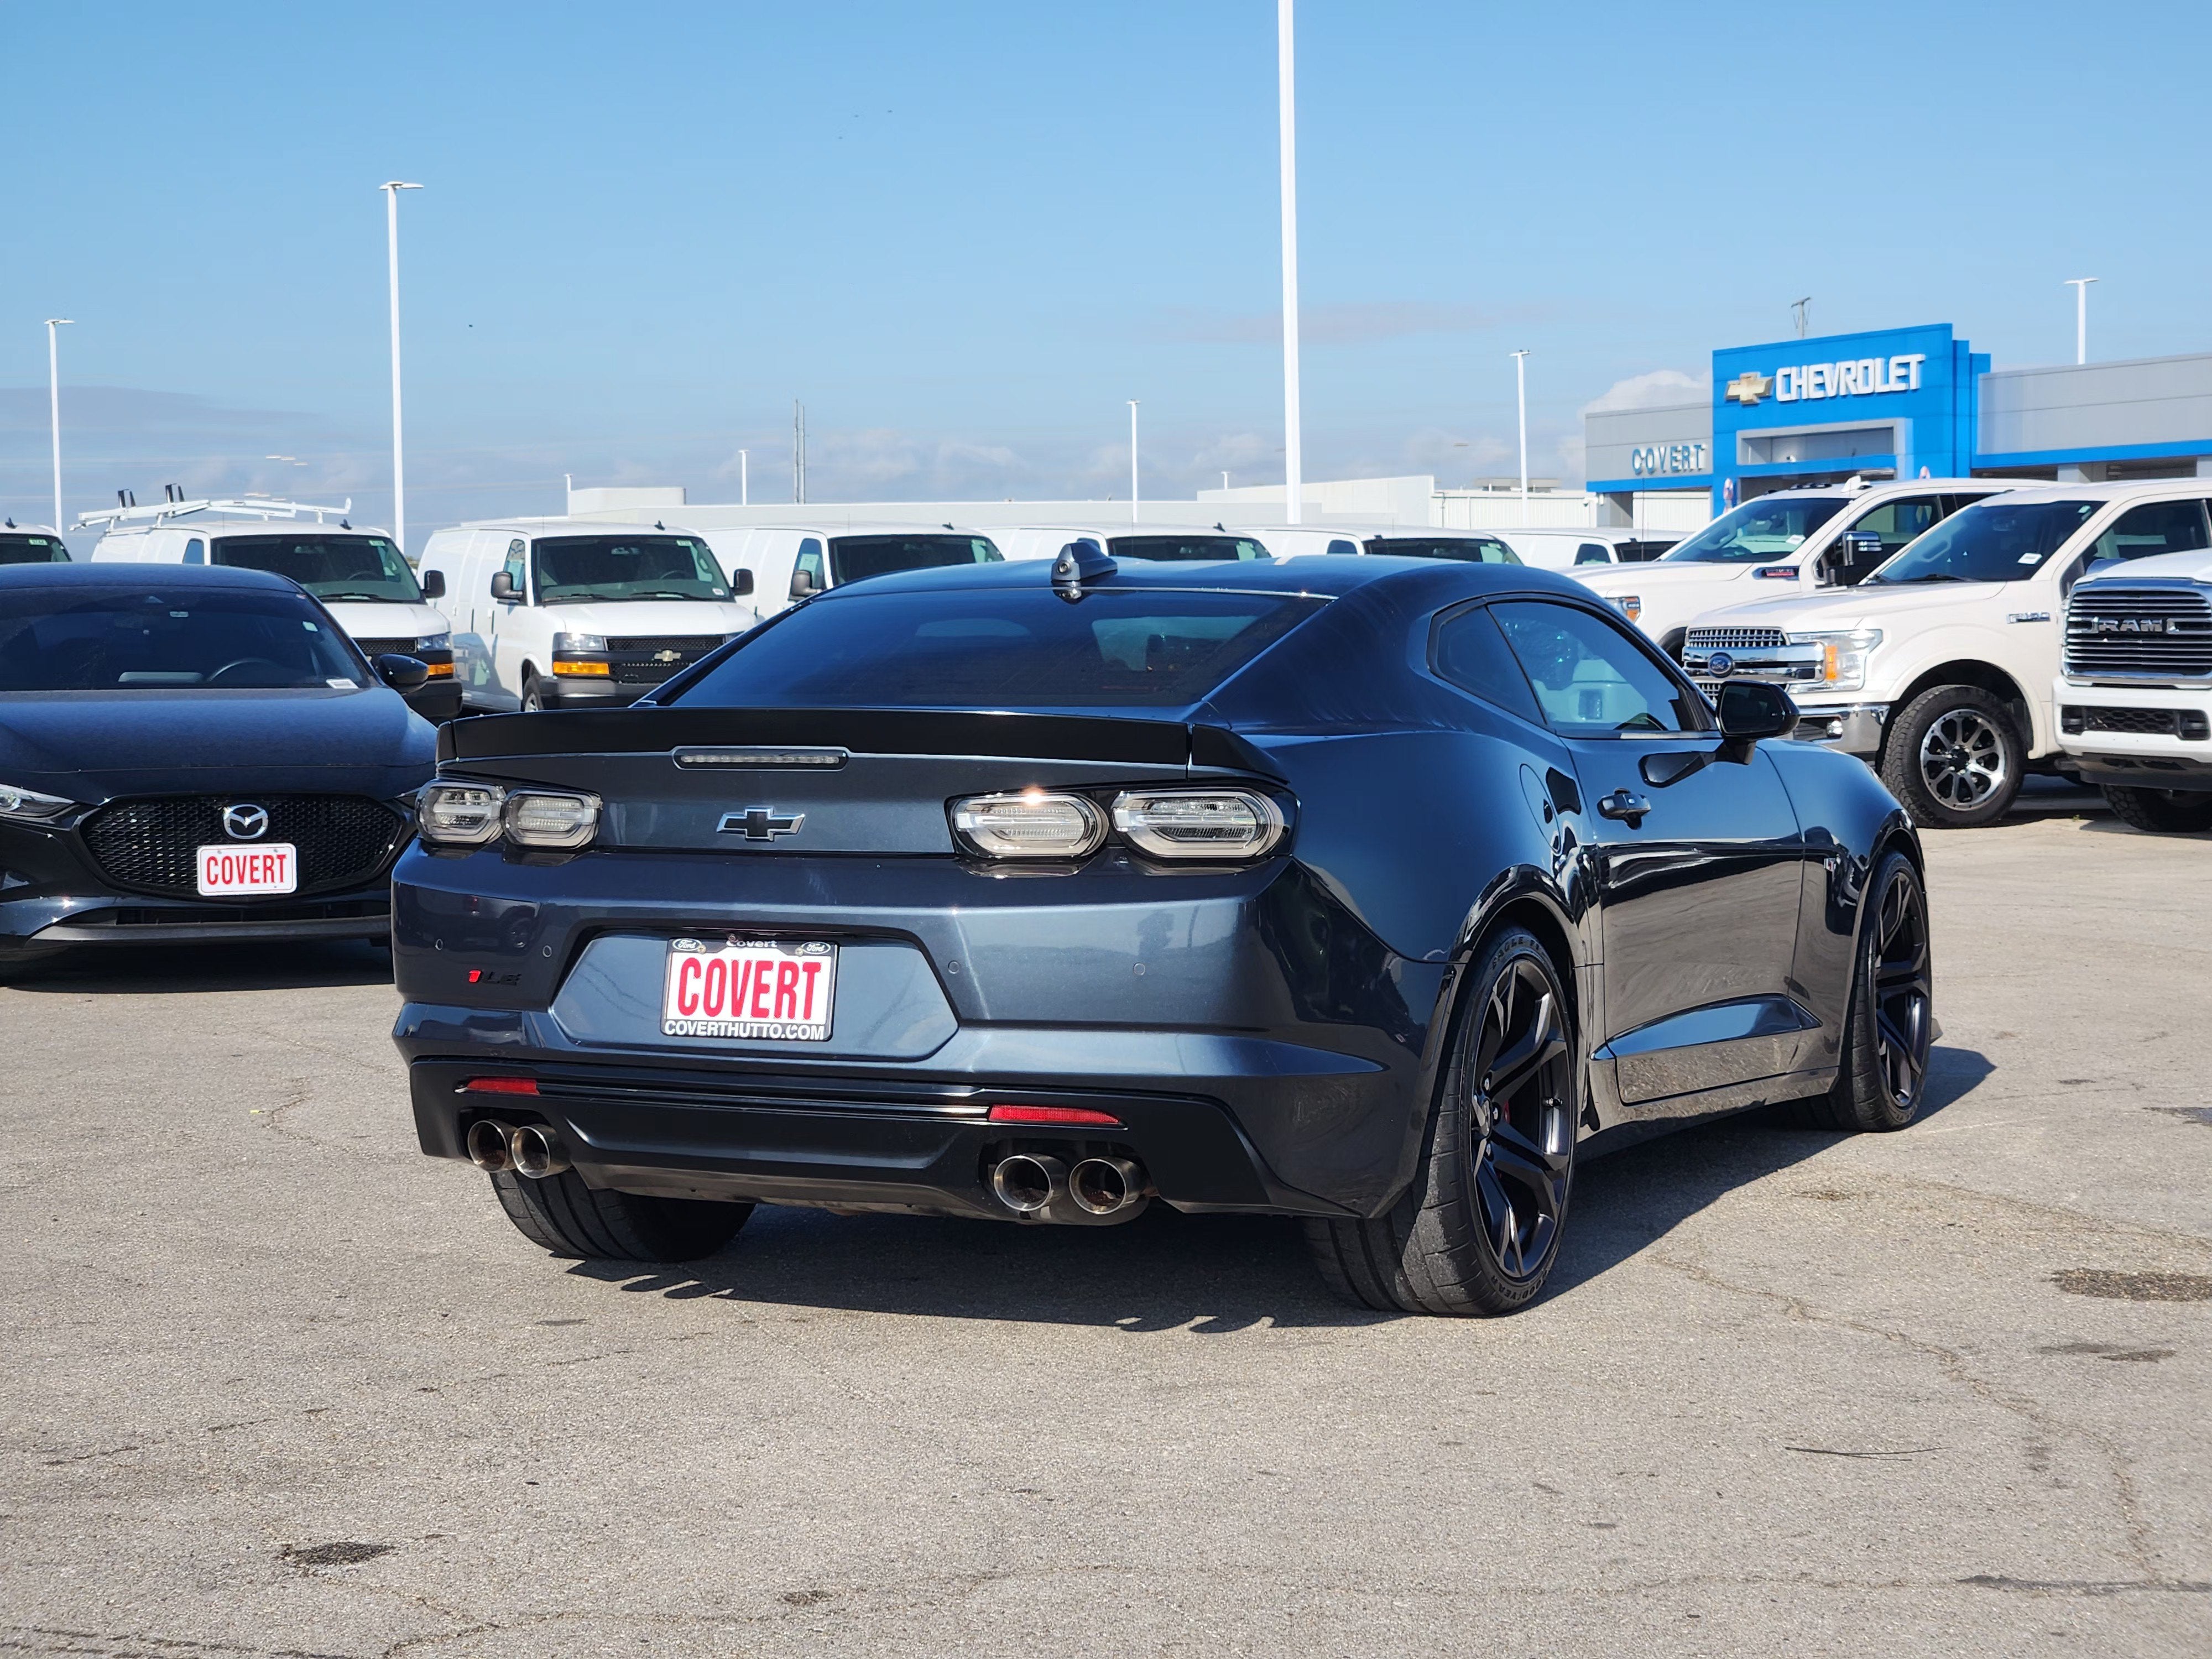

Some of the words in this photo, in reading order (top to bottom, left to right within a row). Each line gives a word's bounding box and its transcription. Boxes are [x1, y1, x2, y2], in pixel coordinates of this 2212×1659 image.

[1776, 354, 1926, 402] CHEVROLET
[1632, 445, 1707, 476] COVERT
[2099, 619, 2163, 633] RAM
[206, 854, 287, 885] COVERT
[726, 940, 778, 948] Covert
[468, 969, 521, 987] 1LE
[677, 957, 822, 1020] COVERT
[664, 1020, 824, 1040] COVERTHUTTO.COM
